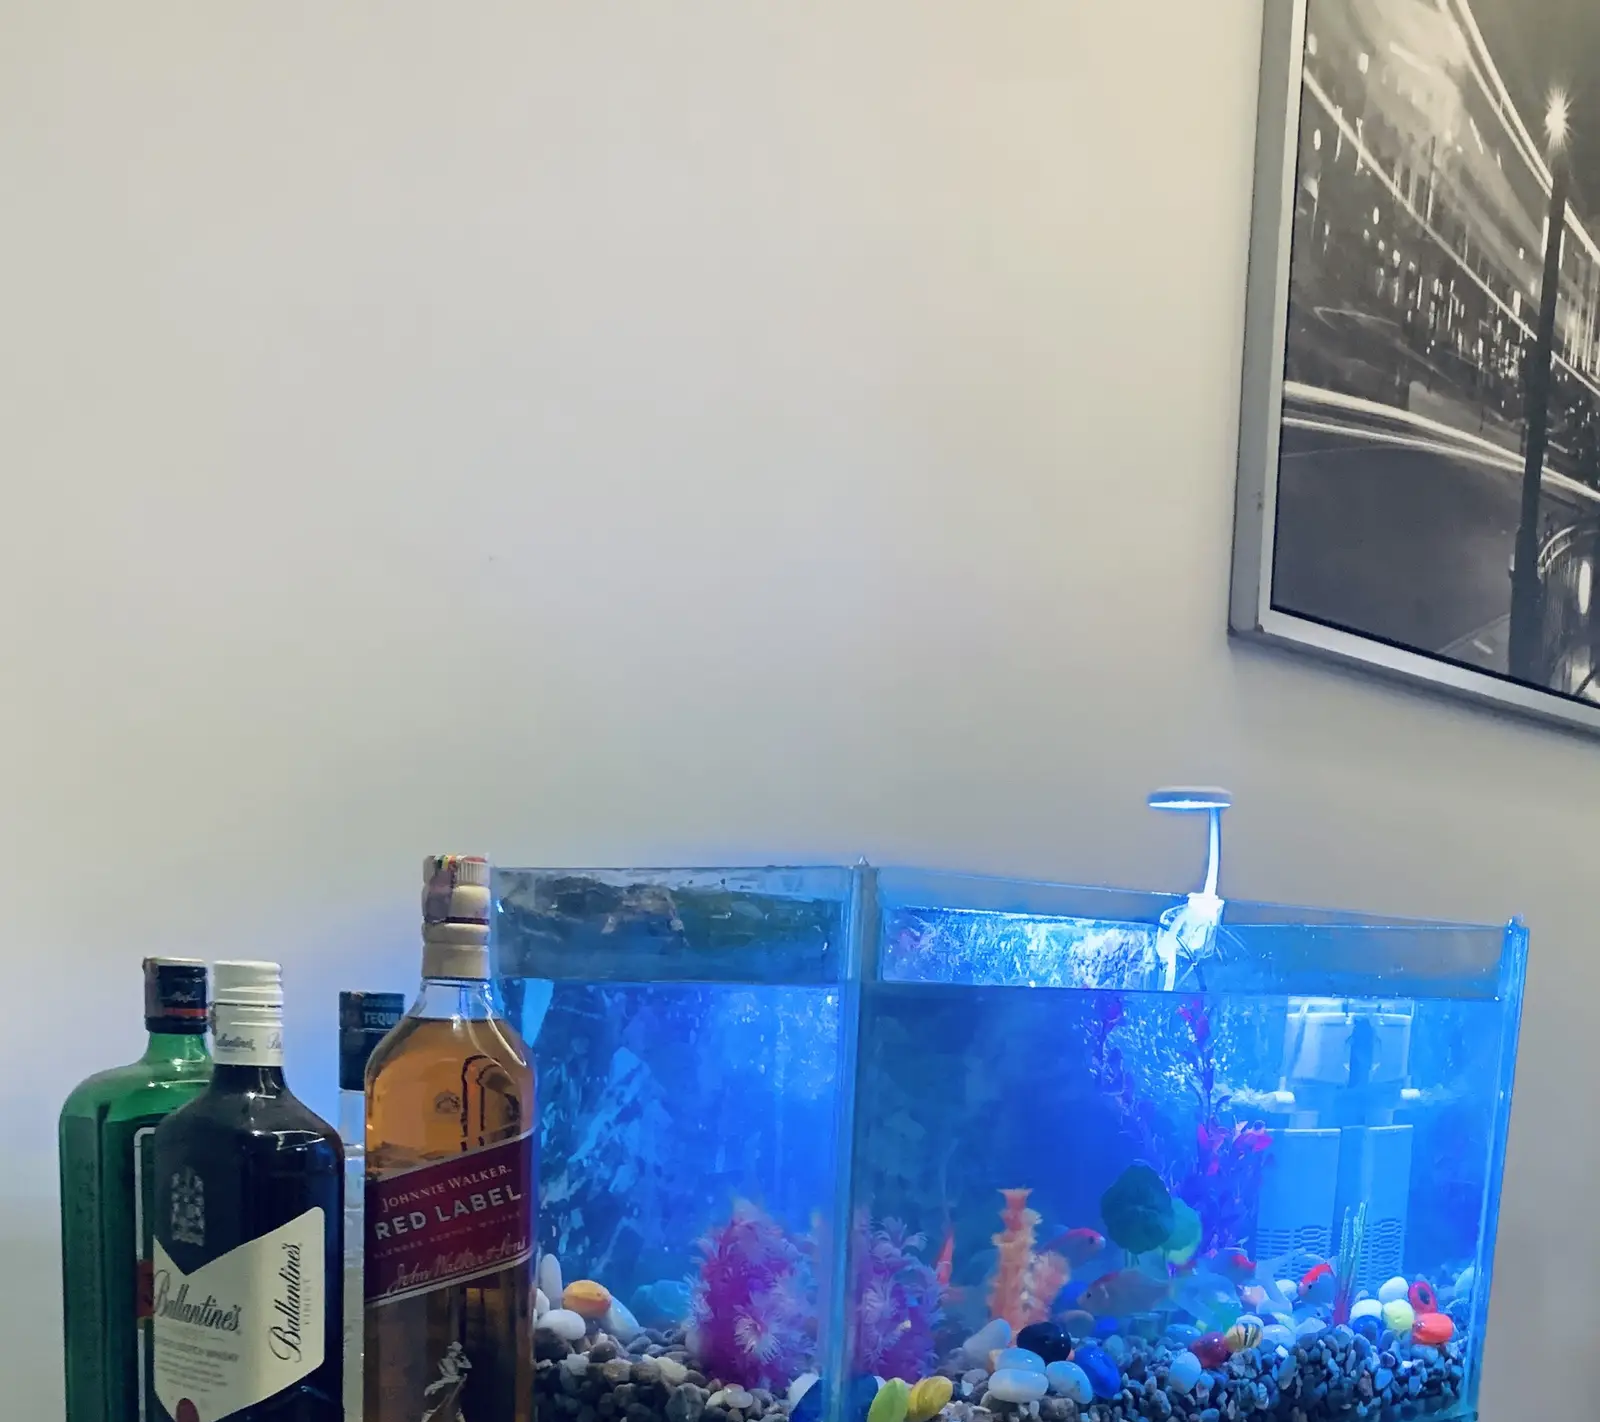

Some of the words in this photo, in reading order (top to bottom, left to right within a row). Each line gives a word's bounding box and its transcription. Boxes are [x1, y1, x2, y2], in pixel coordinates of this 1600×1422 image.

[363, 1012, 404, 1026] TEQUI
[374, 1211, 427, 1240] RED
[435, 1184, 522, 1222] LABEL
[382, 1182, 446, 1213] JOHNNIE
[447, 1164, 508, 1190] WALKER
[154, 1269, 242, 1332] Ballantine's
[268, 1242, 302, 1363] Ballantine's
